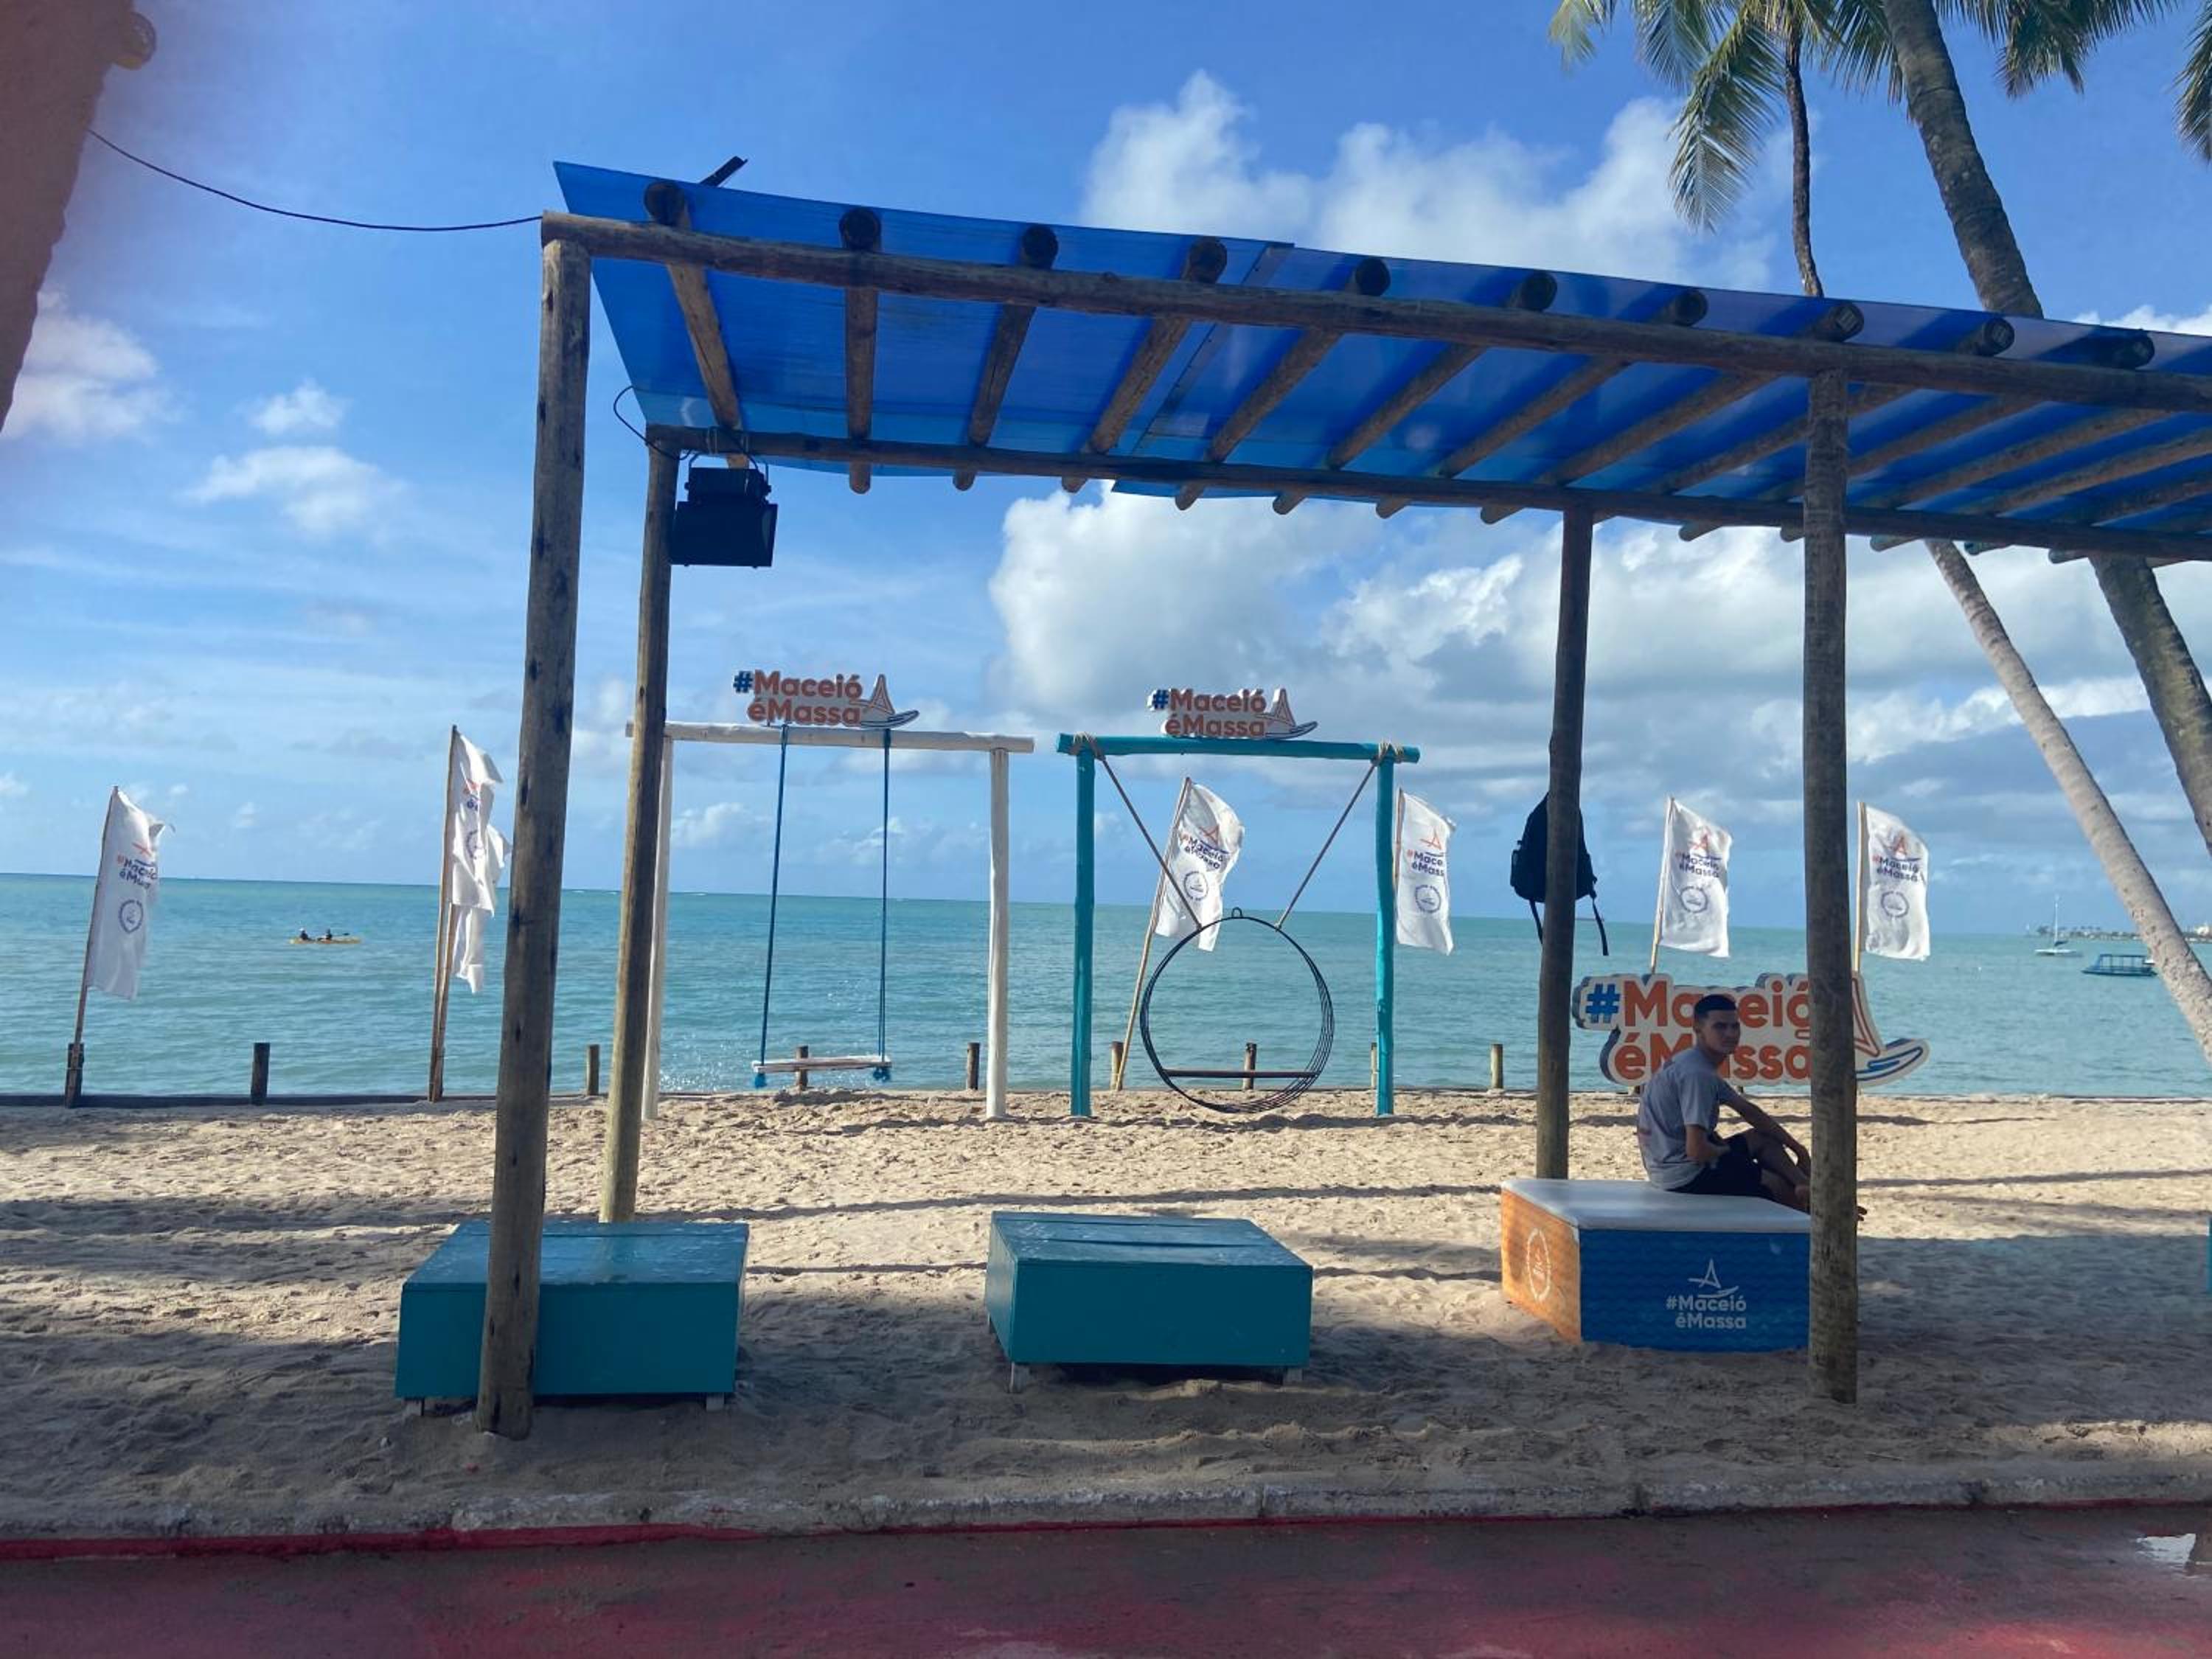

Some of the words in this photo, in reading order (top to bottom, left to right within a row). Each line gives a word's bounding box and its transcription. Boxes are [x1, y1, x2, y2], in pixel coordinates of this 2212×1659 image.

[733, 669, 863, 698] #Maceió
[747, 698, 861, 726] éMassa
[1152, 688, 1267, 713] #Maceió
[1164, 713, 1265, 737] éMassa
[1407, 849, 1443, 866] #Mace
[1411, 860, 1444, 877] éMass
[1585, 980, 1811, 1029] #Maeió
[1666, 1294, 1747, 1312] #Maceió
[1674, 1312, 1747, 1329] éMassa
